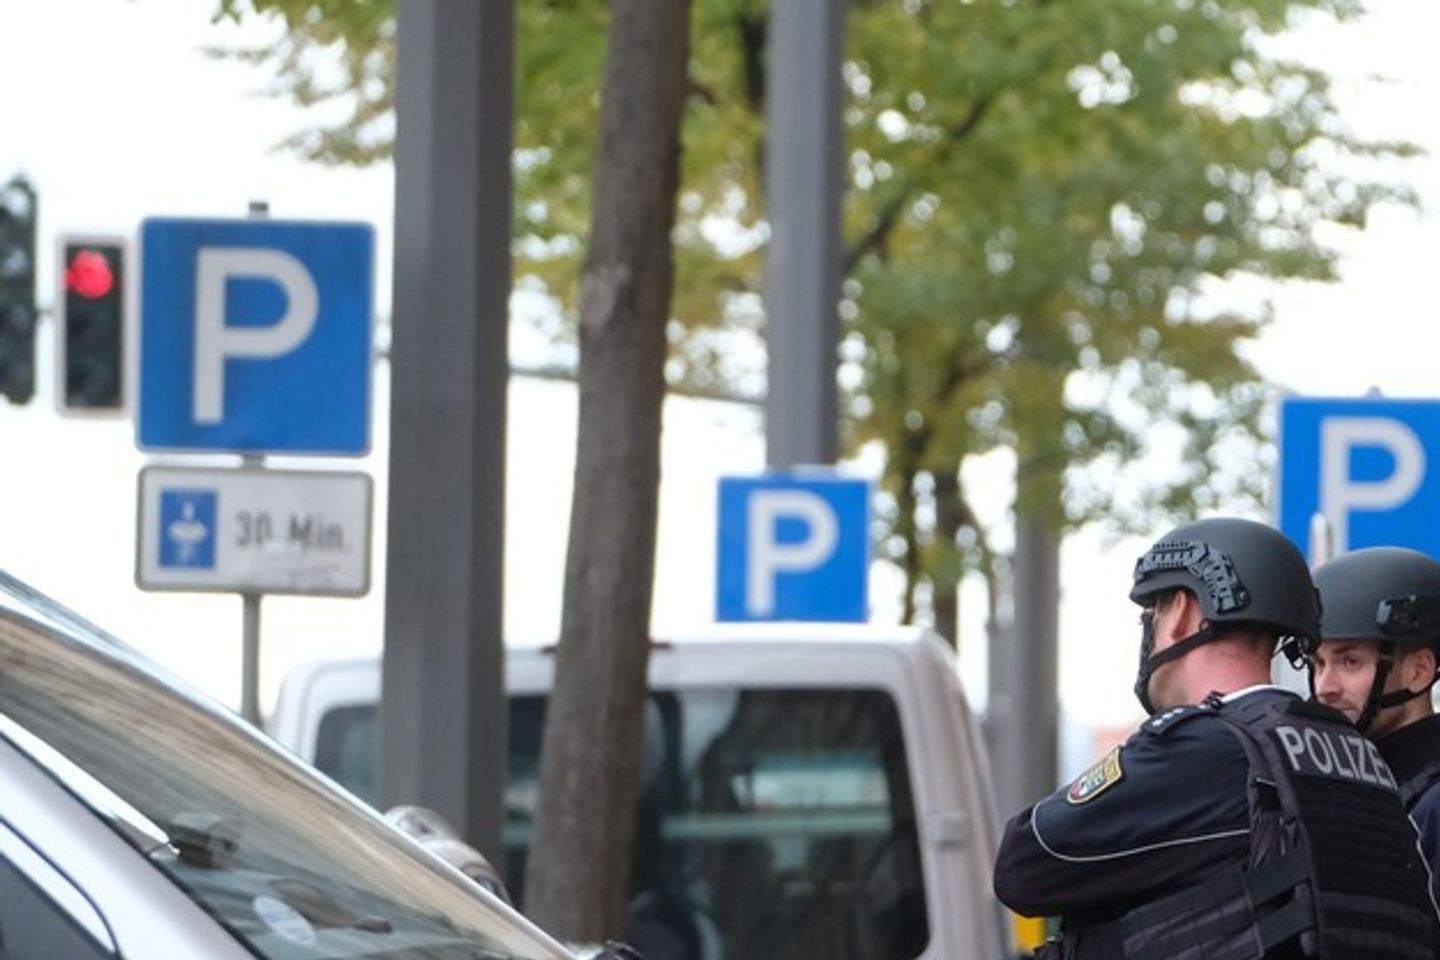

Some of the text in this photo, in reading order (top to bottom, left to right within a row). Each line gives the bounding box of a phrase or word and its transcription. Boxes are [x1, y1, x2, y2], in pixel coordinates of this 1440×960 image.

[193, 246, 319, 425] P
[236, 510, 273, 548] 30
[746, 488, 839, 615] P
[1319, 416, 1427, 559] P
